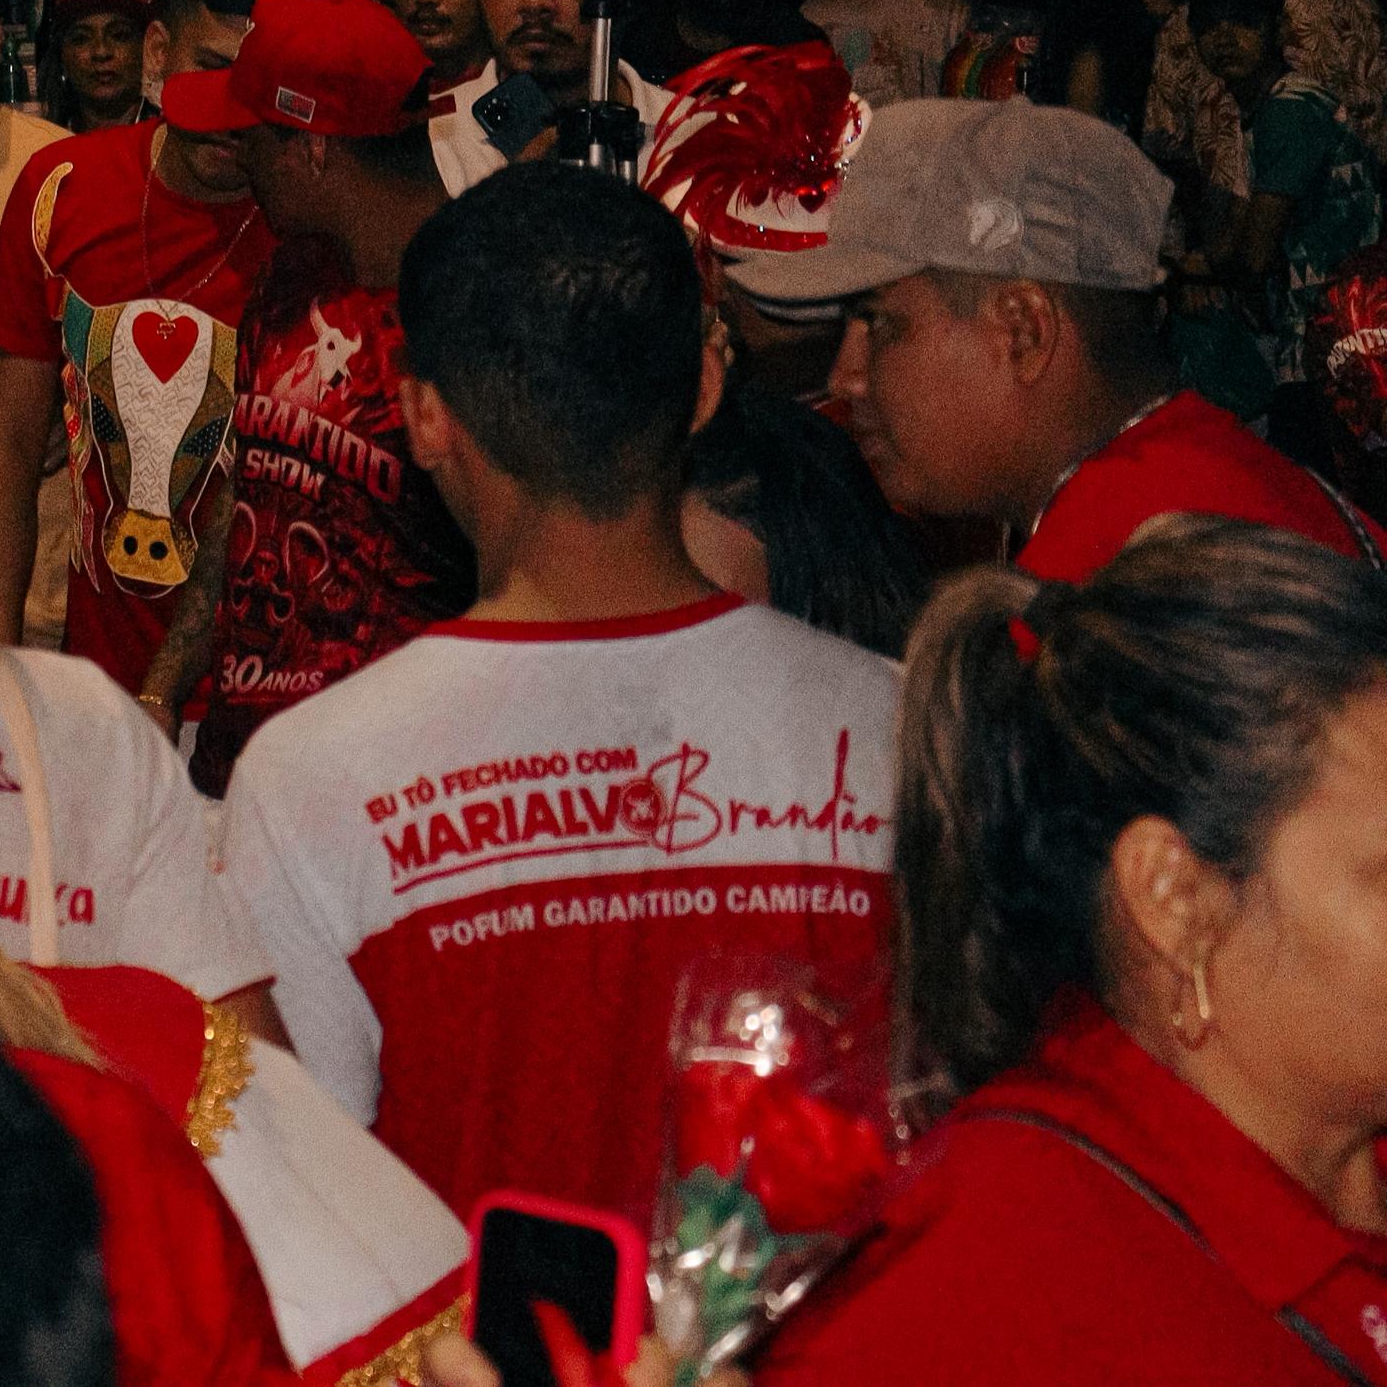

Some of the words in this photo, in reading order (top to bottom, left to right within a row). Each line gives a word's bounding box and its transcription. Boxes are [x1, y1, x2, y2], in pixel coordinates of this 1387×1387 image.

[235, 392, 403, 504] ARANTIDO
[242, 447, 327, 501] SHOW
[220, 653, 264, 694] 30
[258, 669, 325, 694] ANOS
[366, 795, 397, 823] EU
[401, 775, 436, 809] TÔ
[441, 751, 570, 796] FECHADO
[575, 745, 638, 775] COM
[542, 885, 717, 928] GARANTIDO
